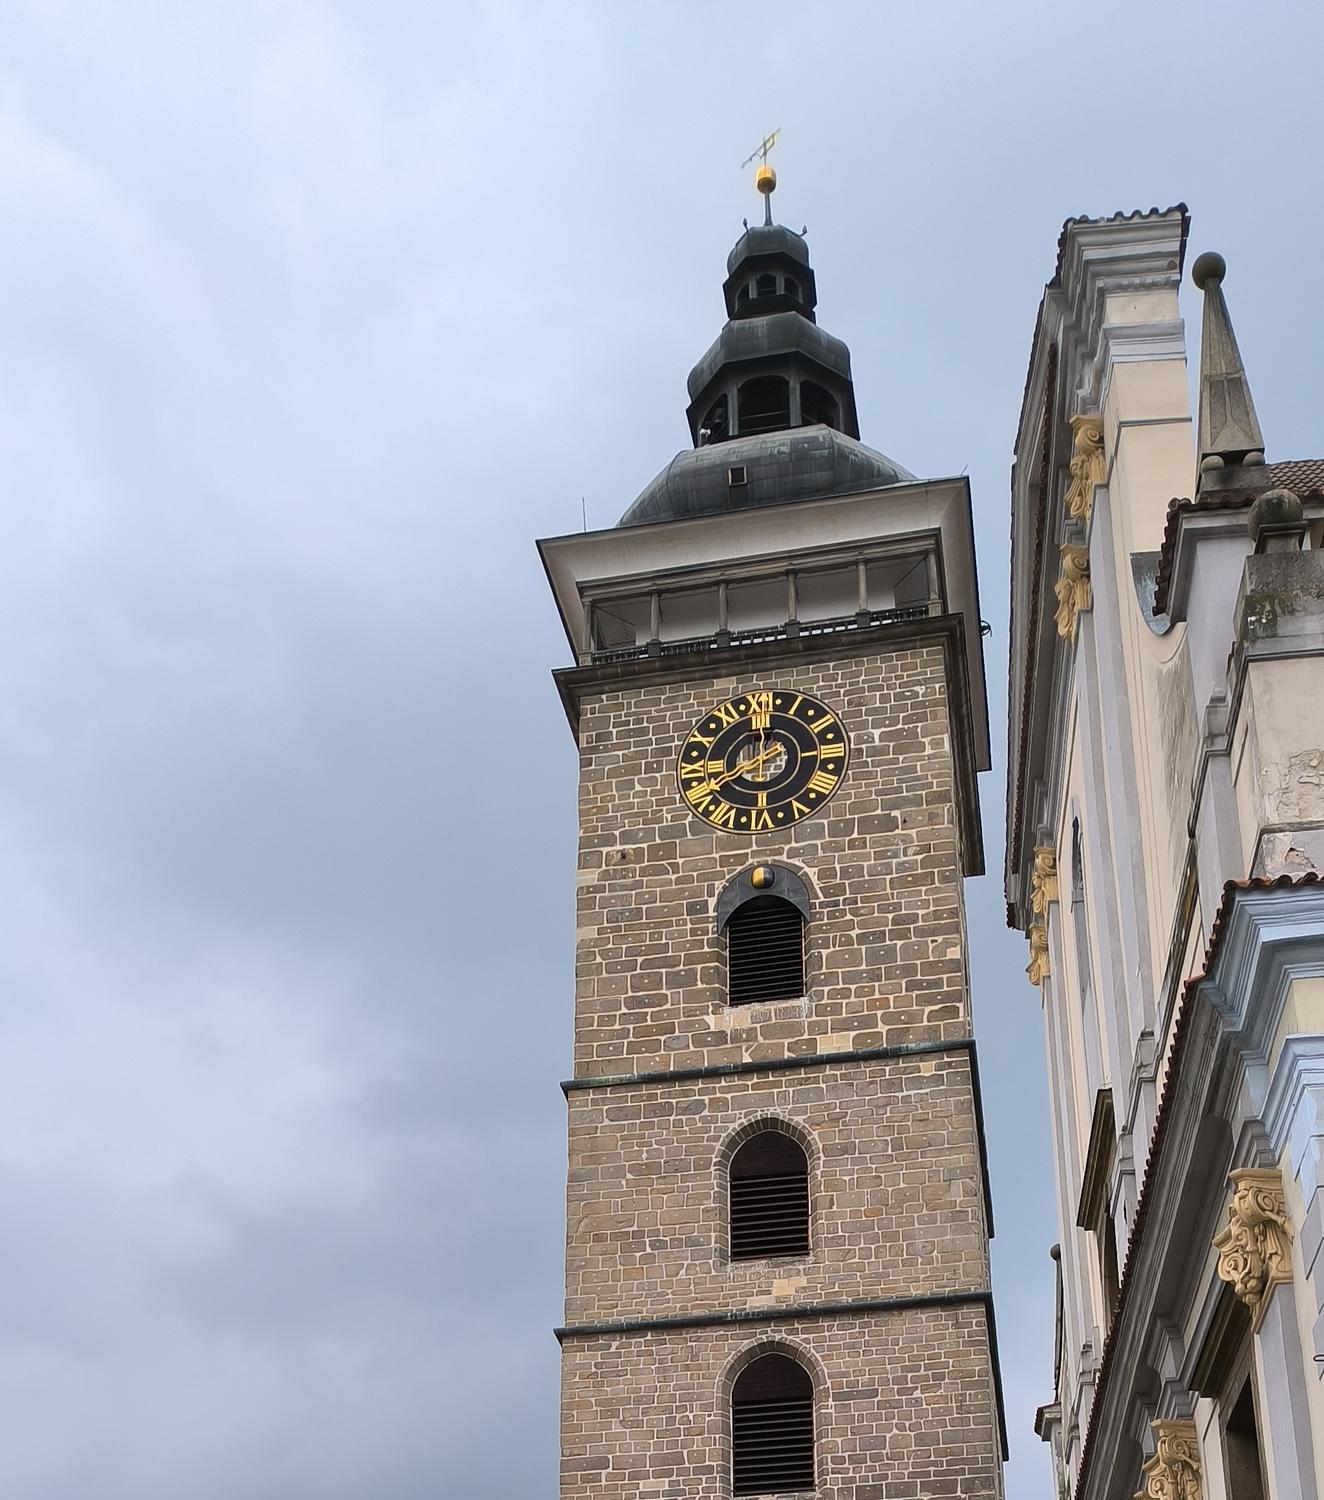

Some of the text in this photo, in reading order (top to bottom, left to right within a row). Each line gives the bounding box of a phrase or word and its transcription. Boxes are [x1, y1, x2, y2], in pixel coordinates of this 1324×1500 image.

[713, 703, 740, 728] XI
[788, 695, 803, 715] I
[809, 713, 835, 733] II
[689, 730, 715, 748] X
[819, 742, 845, 760] III
[681, 759, 704, 780] IX
[808, 770, 839, 795] IIII
[685, 781, 714, 814] VIII
[708, 802, 737, 829] VII
[750, 809, 775, 831] VI
[791, 799, 812, 820] V
